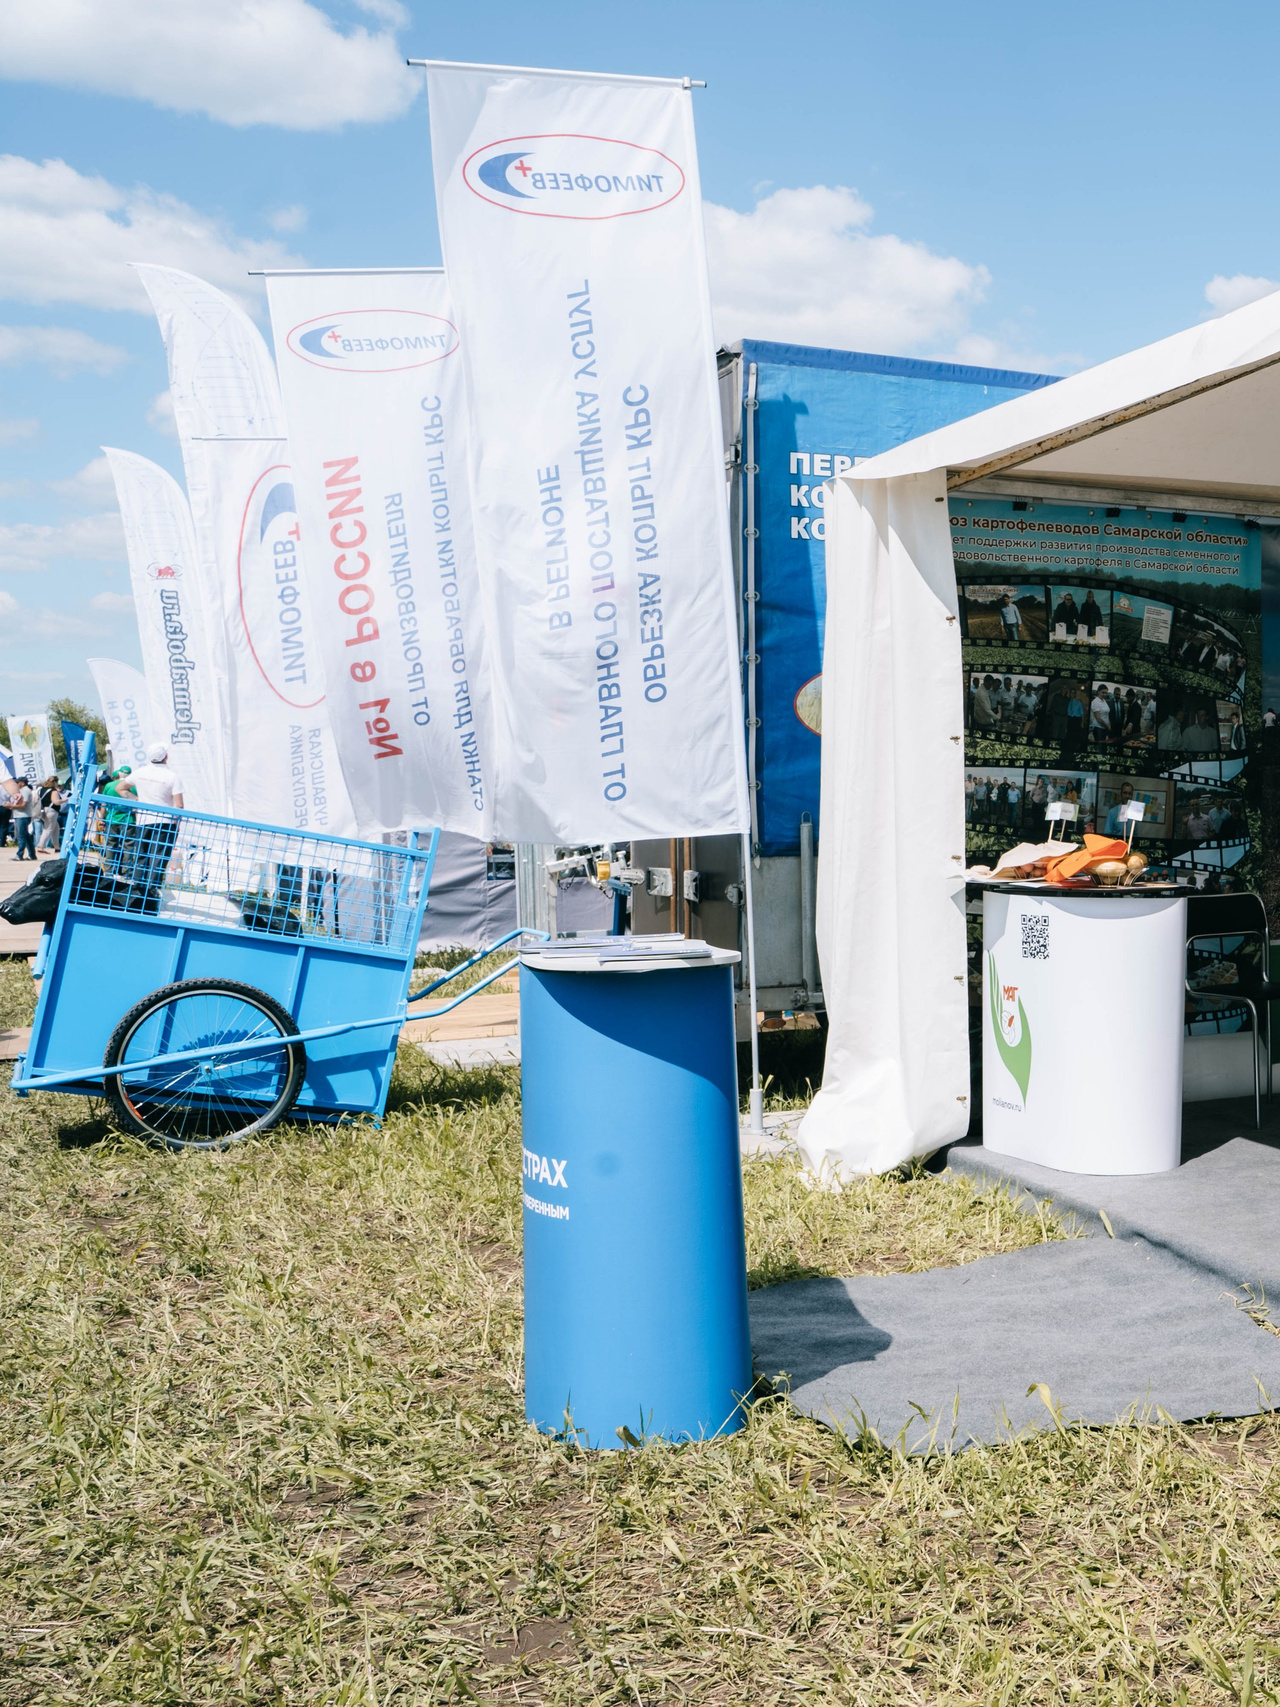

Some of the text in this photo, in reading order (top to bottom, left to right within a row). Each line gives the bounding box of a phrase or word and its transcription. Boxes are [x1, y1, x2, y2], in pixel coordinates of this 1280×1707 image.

[972, 516, 1100, 536] картофелеводов
[1103, 523, 1182, 541] Самарской
[1186, 530, 1249, 546] области»
[968, 536, 1037, 549] поддержки
[1040, 540, 1092, 551] развития
[1095, 543, 1171, 557] производства
[1173, 549, 1231, 562] семенного
[1233, 554, 1241, 562] и
[1064, 555, 1122, 568] картофеля
[1125, 560, 1131, 568] в
[1133, 559, 1193, 573] Самарской
[1196, 563, 1240, 576] области
[992, 1097, 1022, 1112] molianov.ru
